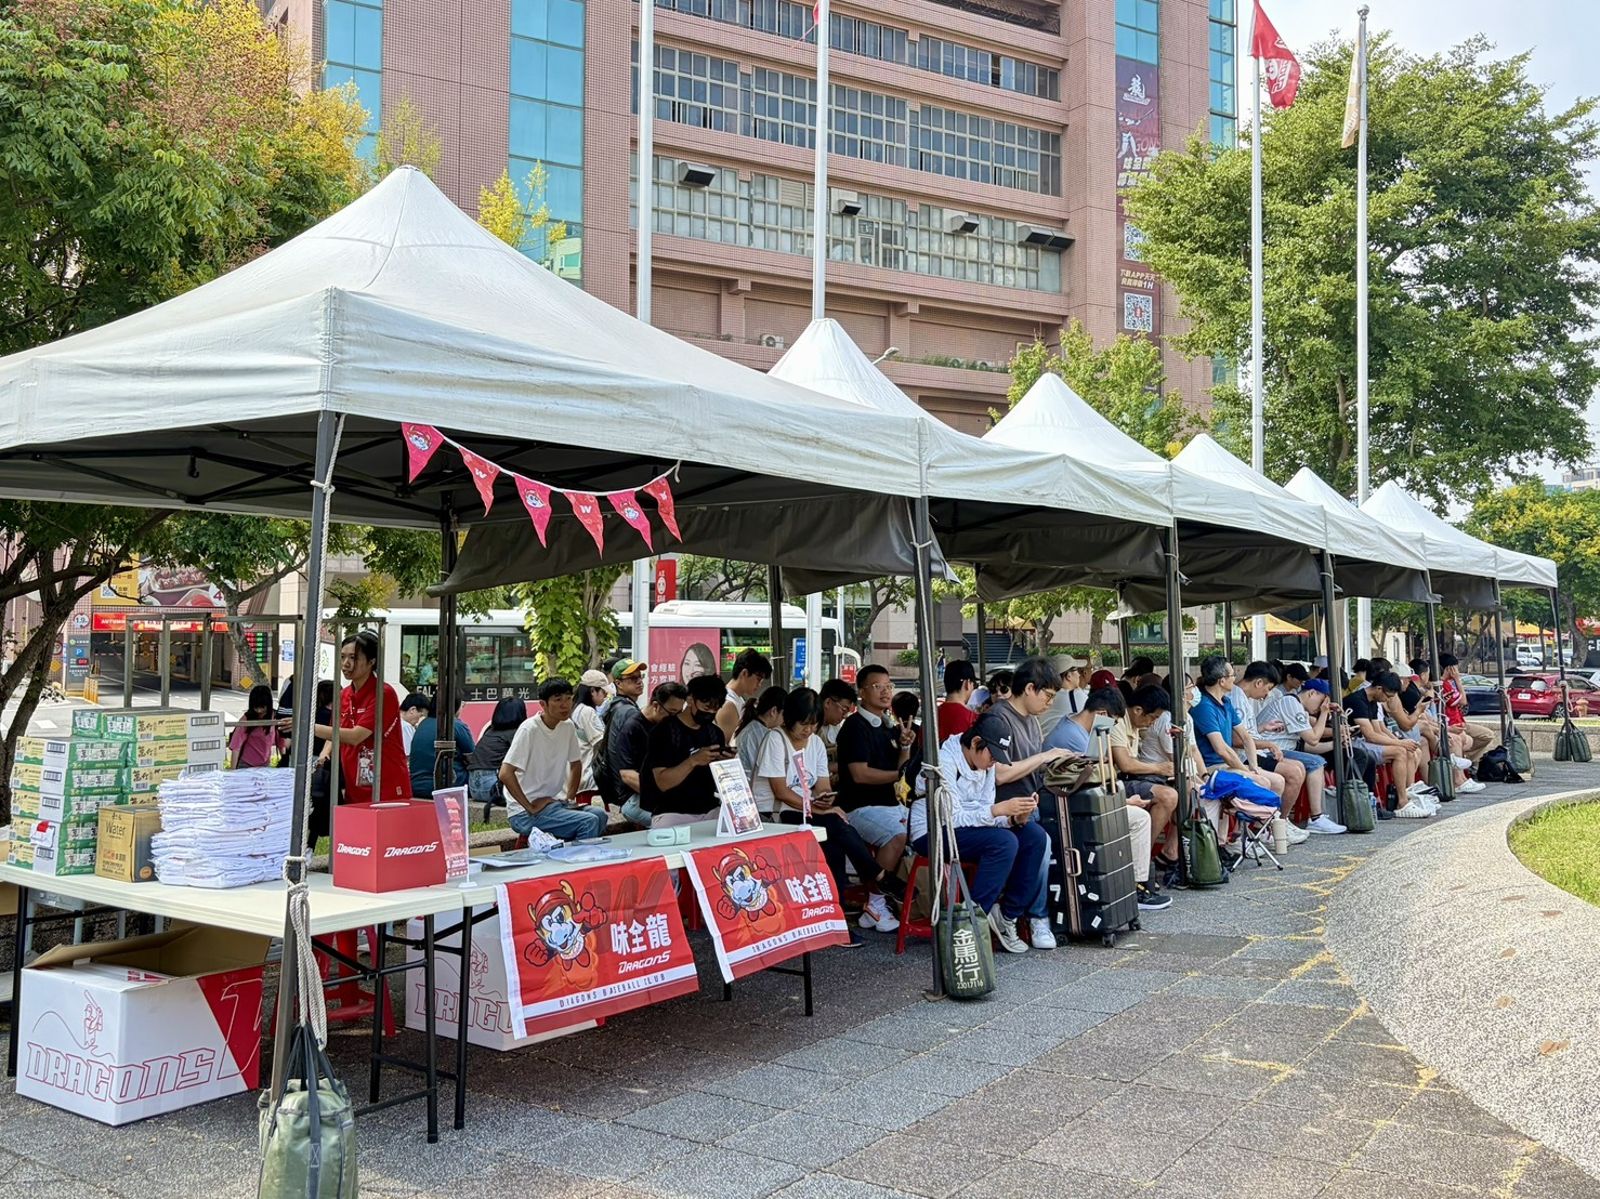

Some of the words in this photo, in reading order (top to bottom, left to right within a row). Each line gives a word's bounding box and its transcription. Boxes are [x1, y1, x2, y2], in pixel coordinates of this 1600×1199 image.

[579, 504, 592, 514] W
[105, 821, 126, 836] Water
[784, 871, 834, 904] 味全龍
[610, 912, 672, 956] 味全龍
[952, 928, 981, 982] 金馬行
[25, 1041, 217, 1105] DRAGONS
